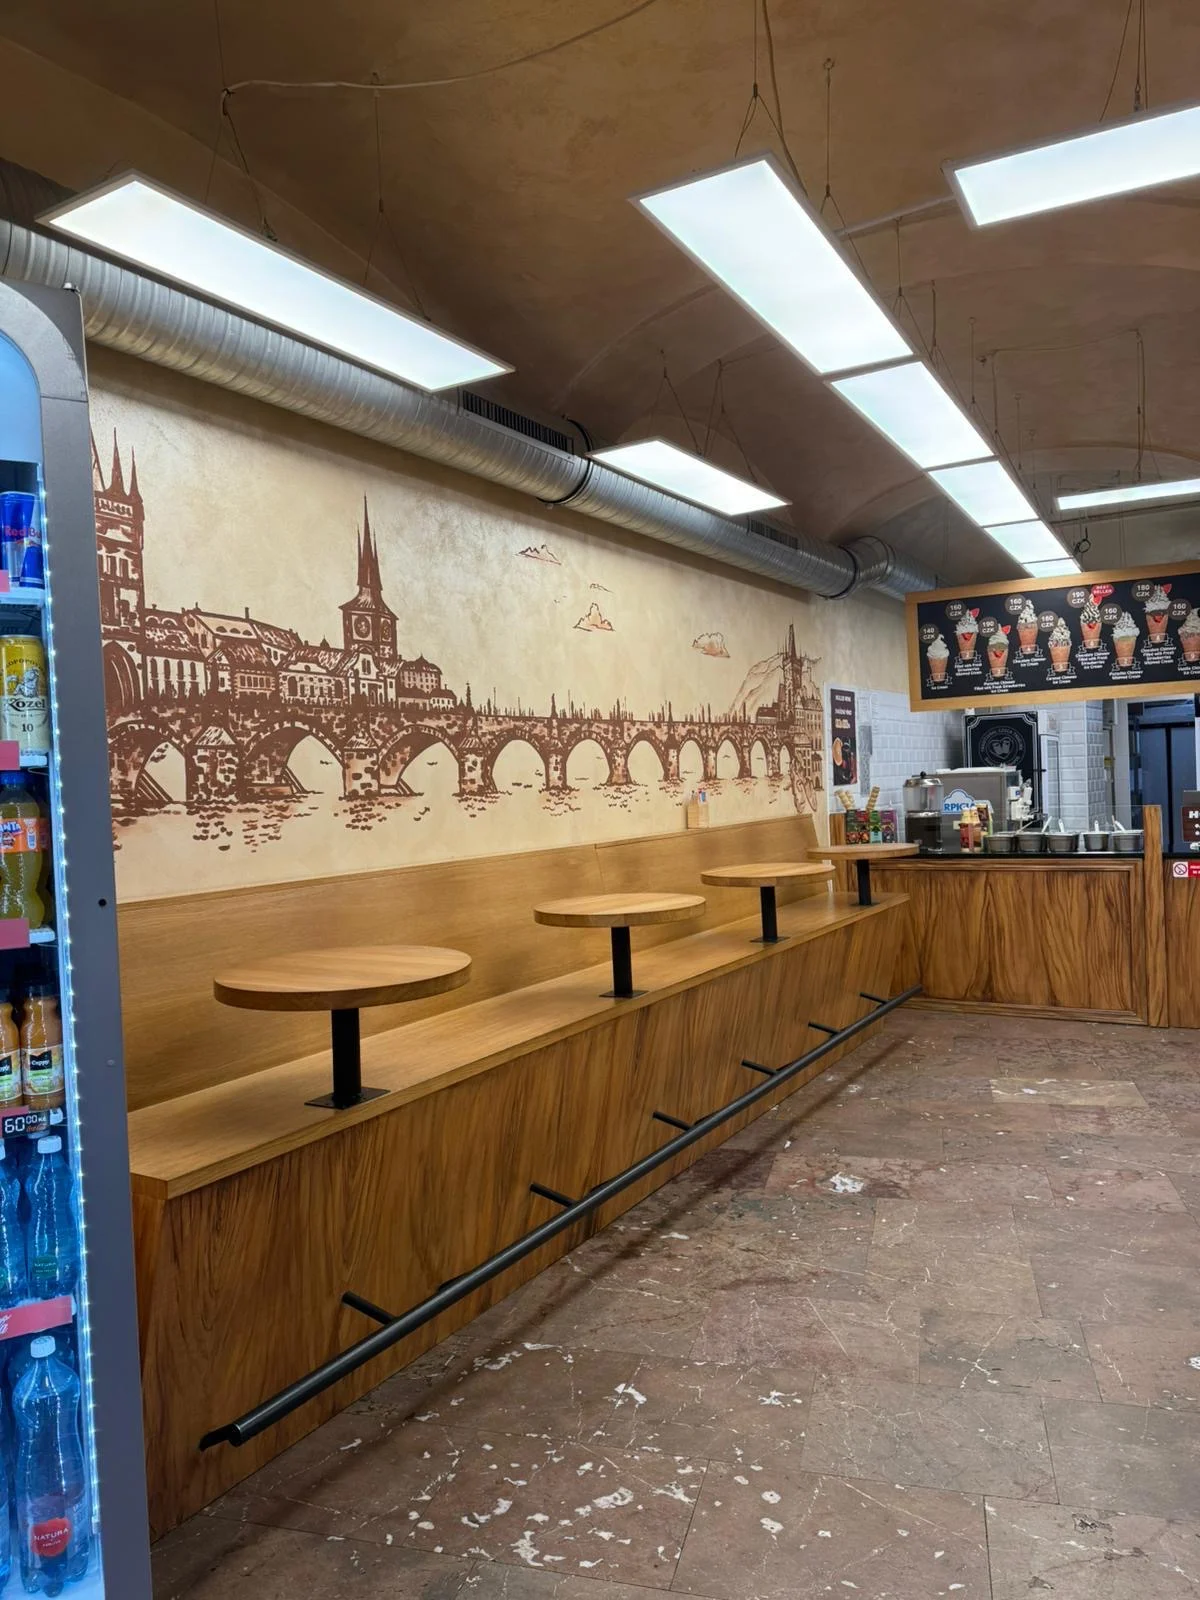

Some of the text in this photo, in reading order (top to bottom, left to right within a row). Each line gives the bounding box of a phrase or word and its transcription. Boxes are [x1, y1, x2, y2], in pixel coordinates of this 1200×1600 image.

[5, 525, 26, 537] Red
[9, 698, 46, 711] Kozel
[22, 724, 33, 732] 10
[5, 1117, 25, 1133] 60
[34, 1528, 69, 1540] NATURA
